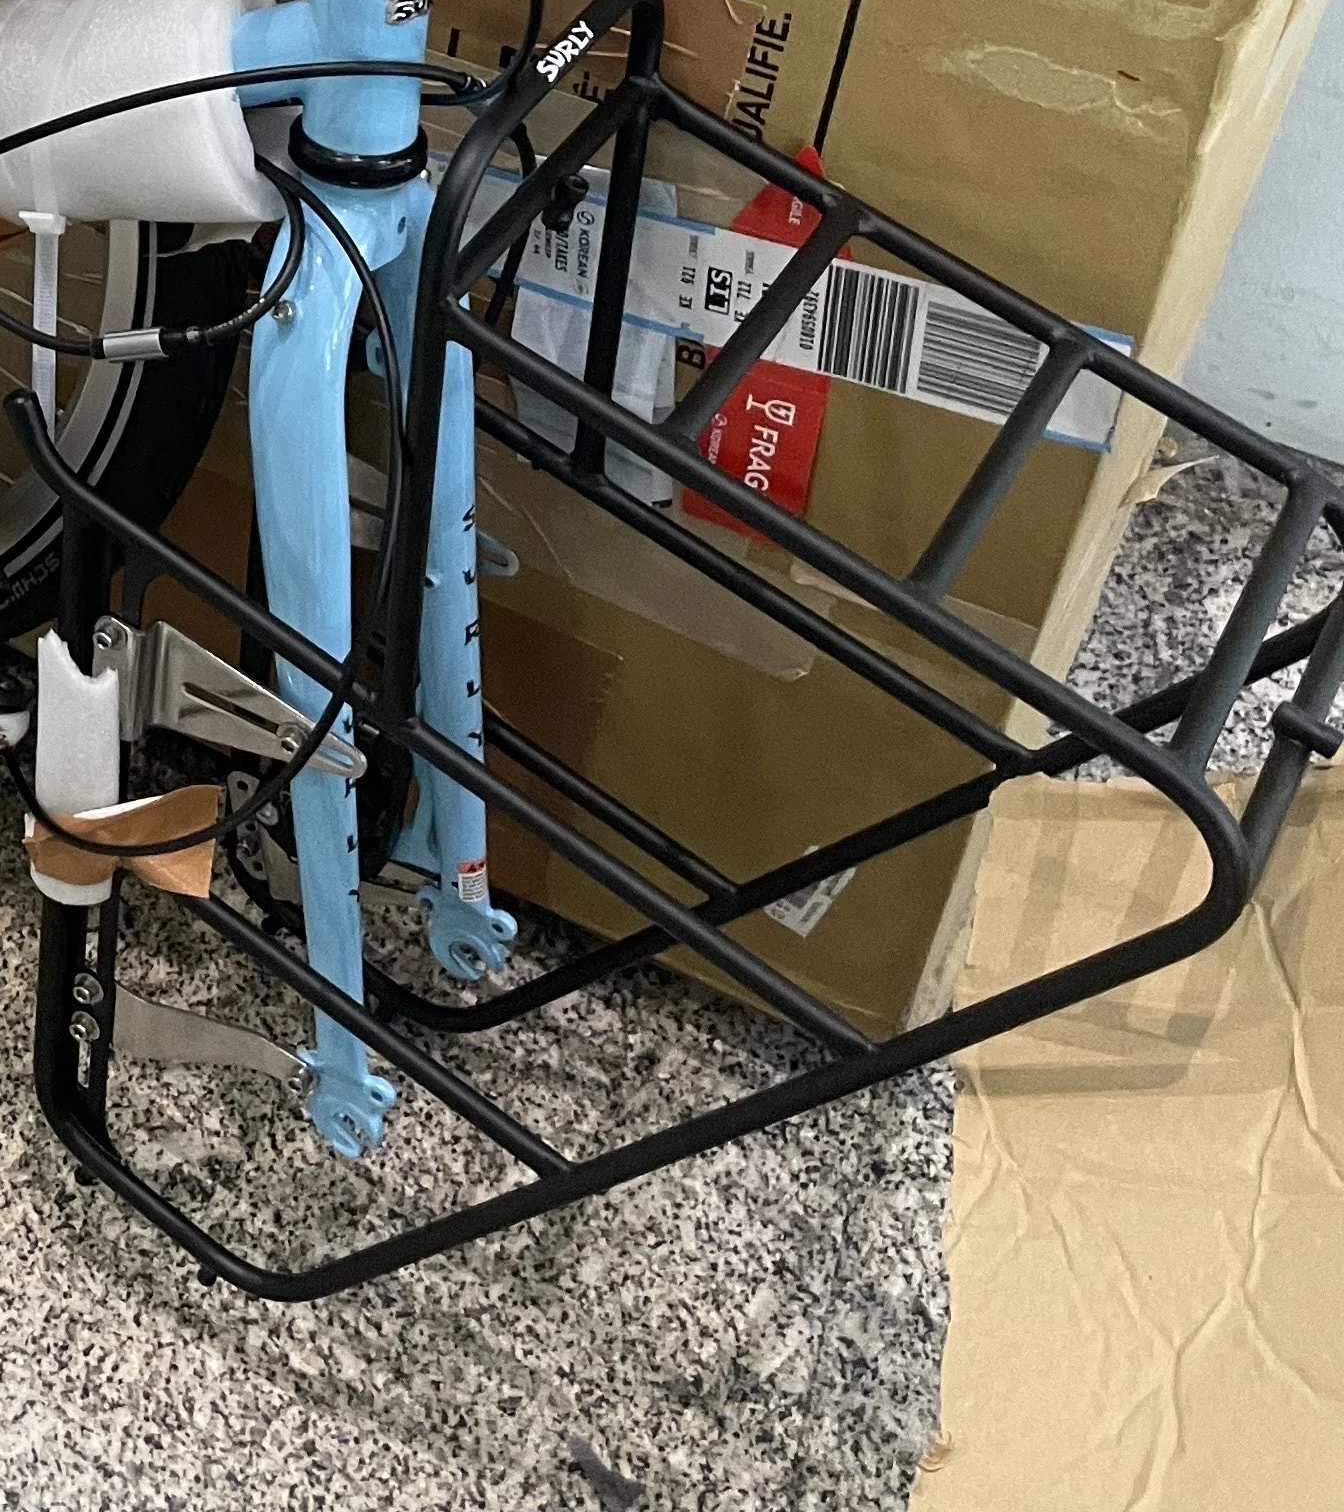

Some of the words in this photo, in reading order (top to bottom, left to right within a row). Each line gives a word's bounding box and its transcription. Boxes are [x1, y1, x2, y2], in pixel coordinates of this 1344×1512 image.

[536, 21, 594, 83] SURLY
[576, 228, 591, 278] KOREAN
[744, 424, 779, 491] FRAG
